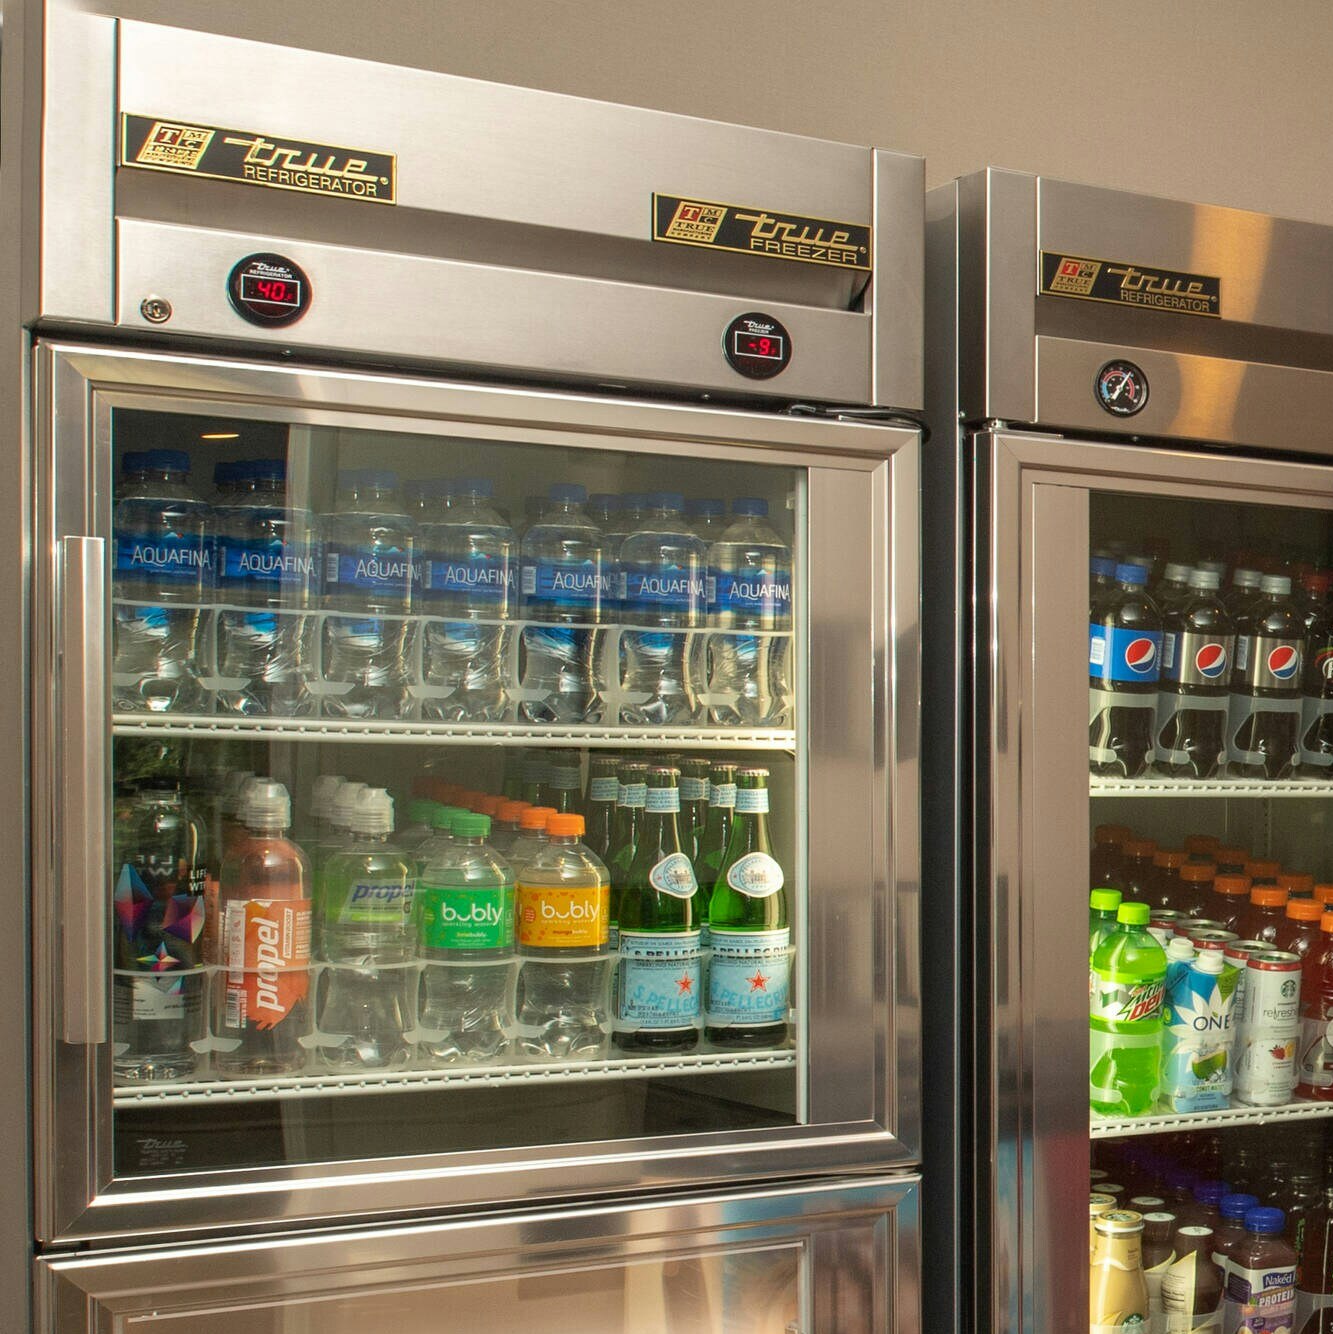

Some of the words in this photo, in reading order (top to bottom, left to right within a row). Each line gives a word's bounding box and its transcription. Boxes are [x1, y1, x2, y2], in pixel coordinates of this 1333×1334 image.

[243, 165, 378, 196] REFRIGERATOR
[750, 237, 858, 264] FREEZER
[257, 281, 287, 301] 40
[1121, 289, 1210, 312] REFRIGERATOR
[131, 545, 212, 571] AQUAFINA
[238, 552, 318, 575] AQUAFINA
[445, 564, 517, 588] AQUAFINA
[639, 576, 706, 597] AQUAFINA
[729, 581, 791, 600] AQUAFINA
[352, 879, 415, 904] propel
[442, 902, 503, 926] bubly
[541, 900, 600, 923] bubly
[251, 916, 286, 1013] propel
[1193, 1014, 1231, 1031] ONE
[1265, 1270, 1293, 1287] Naked
